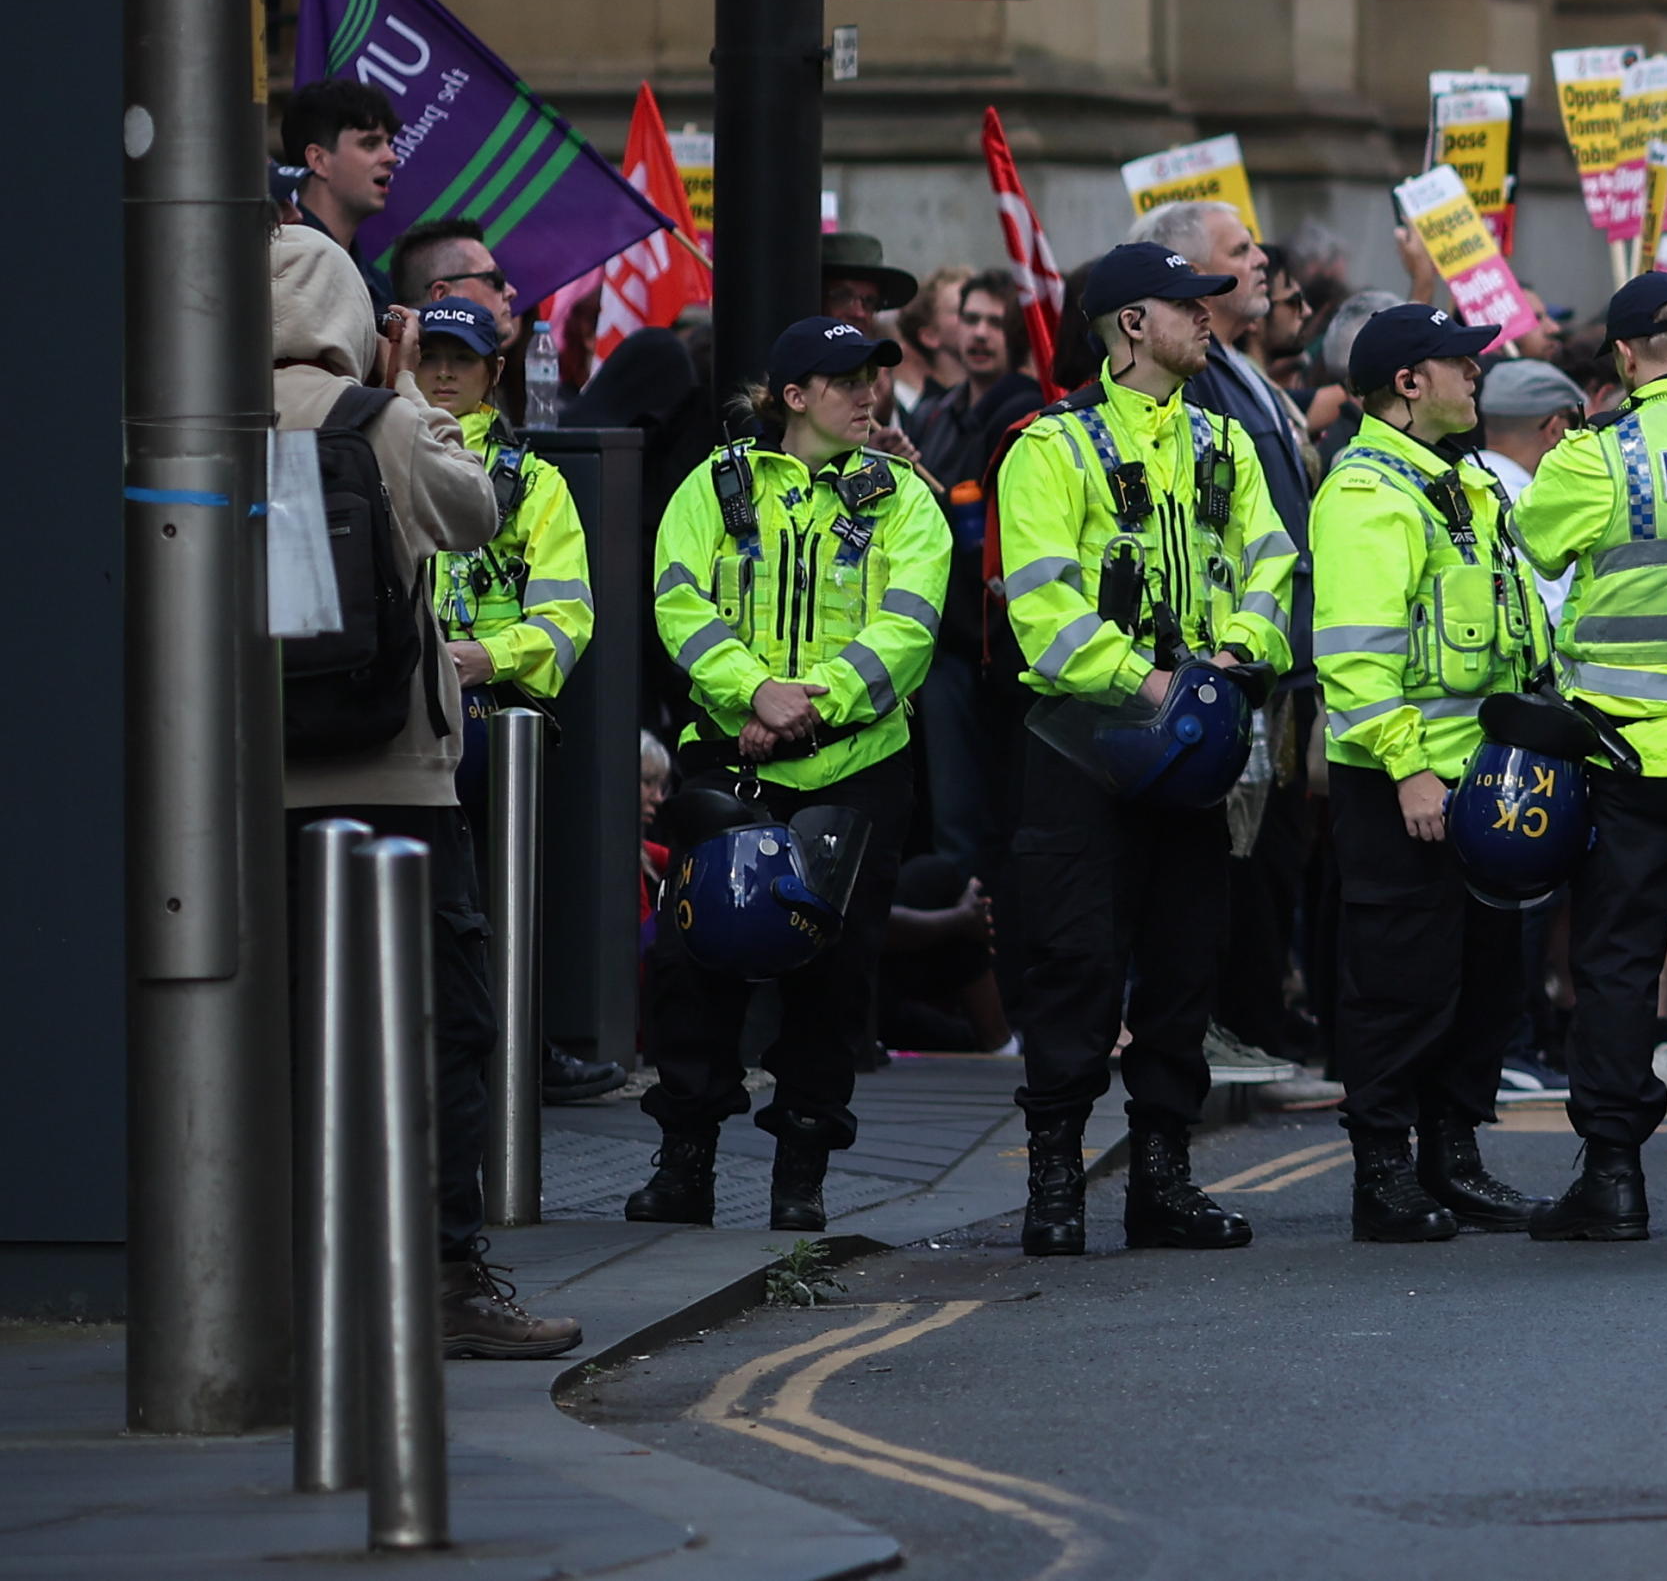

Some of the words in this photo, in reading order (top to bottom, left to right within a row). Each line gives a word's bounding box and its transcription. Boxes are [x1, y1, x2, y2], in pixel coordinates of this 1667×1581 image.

[1444, 131, 1487, 156] pose
[424, 309, 476, 325] POLICE
[1531, 765, 1555, 797] K
[1491, 799, 1549, 838] CK
